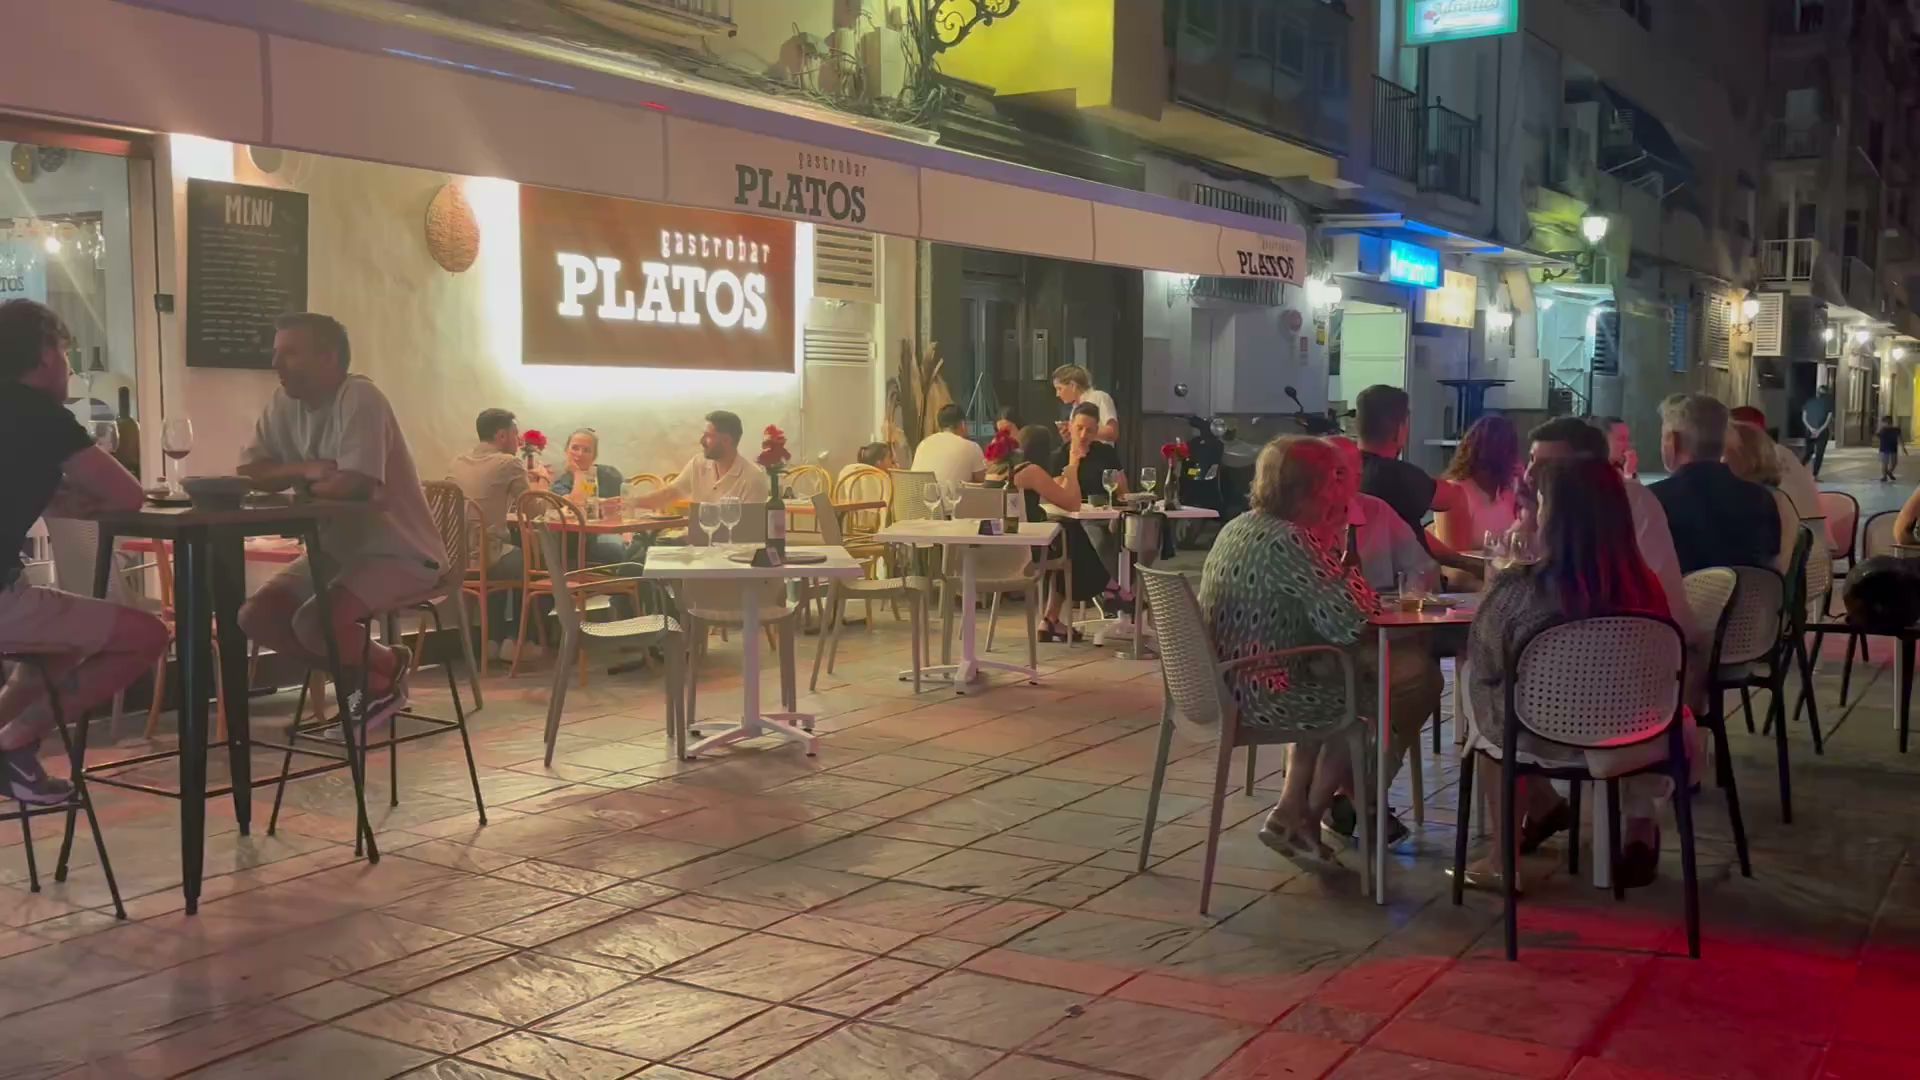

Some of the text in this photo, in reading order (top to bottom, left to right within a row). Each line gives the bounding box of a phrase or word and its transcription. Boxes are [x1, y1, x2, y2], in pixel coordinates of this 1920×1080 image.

[734, 163, 866, 223] PLATOS
[660, 229, 770, 264] gastrobar
[1237, 249, 1294, 280] PLATOS
[557, 252, 768, 330] PLATOS
